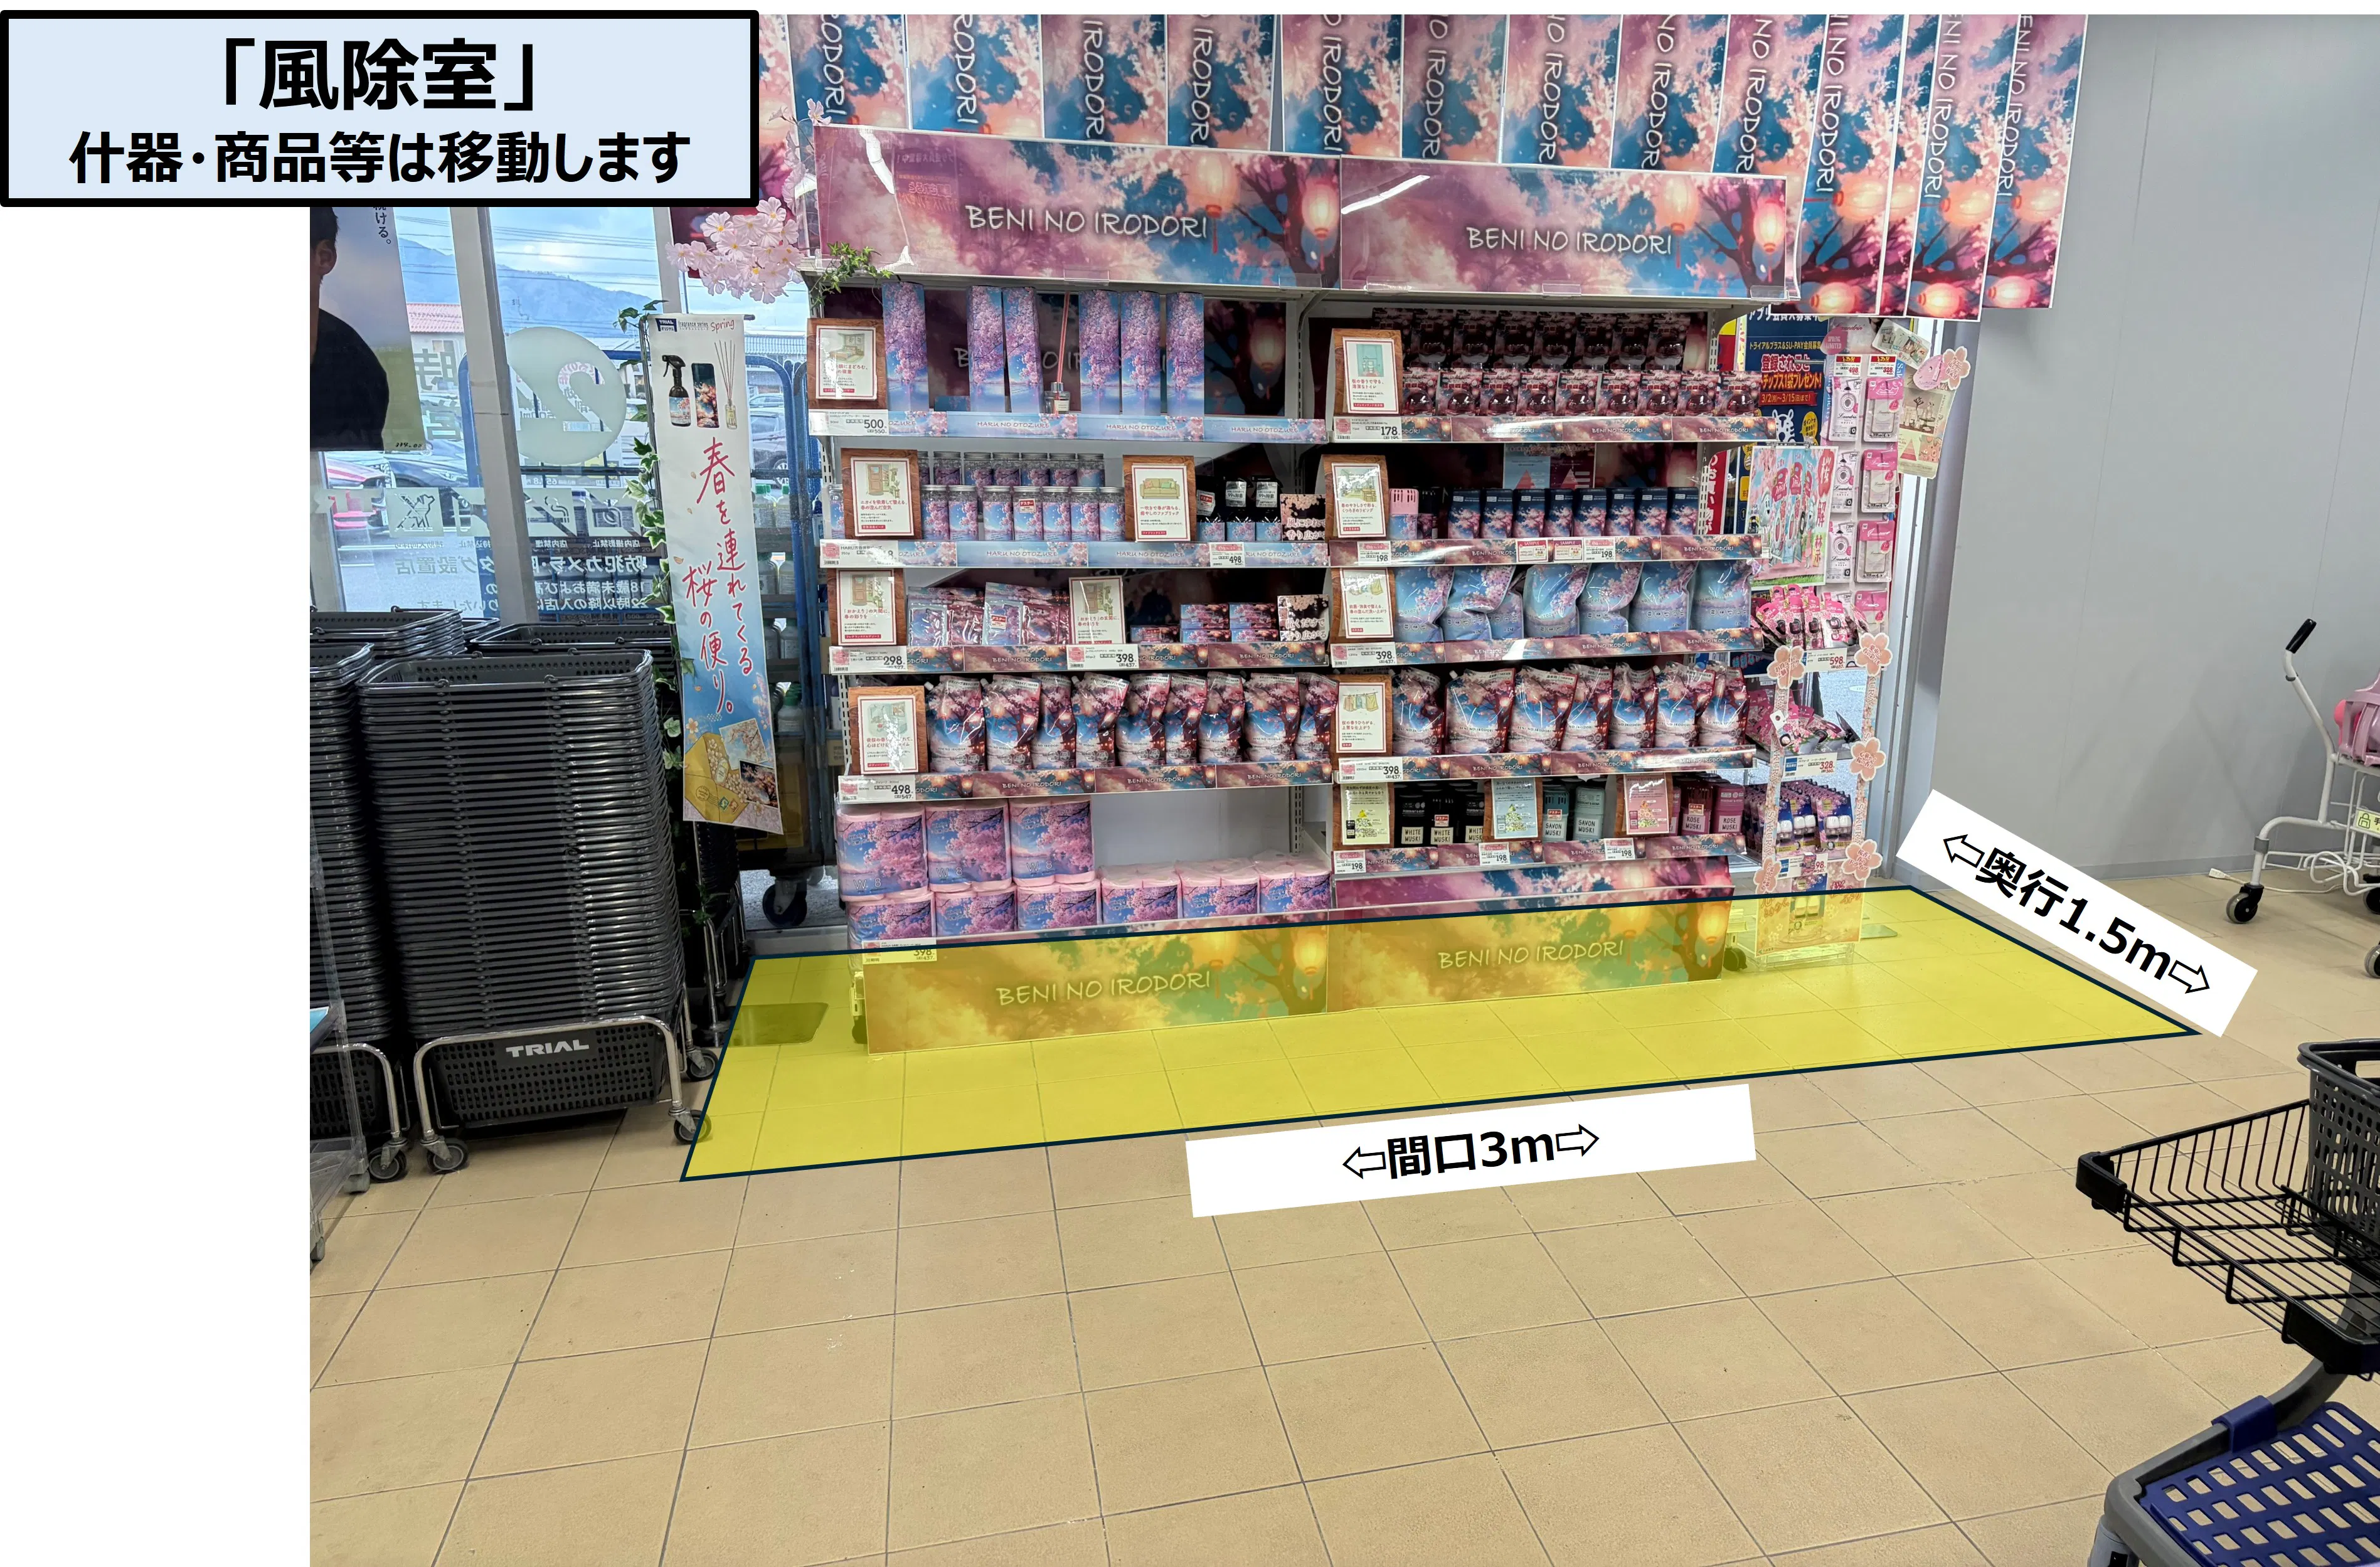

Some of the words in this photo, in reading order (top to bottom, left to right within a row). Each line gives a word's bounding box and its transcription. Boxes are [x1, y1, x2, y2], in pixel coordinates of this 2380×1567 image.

[1751, 18, 1773, 59] NO
[1827, 36, 1846, 76] NO
[1939, 56, 1958, 90] NO
[1323, 37, 1343, 151] IRODORI
[1816, 85, 1843, 192] IRODORI
[1925, 99, 1952, 198] IRODORI
[373, 207, 391, 244] ける。
[965, 205, 1034, 231] BENI
[1044, 210, 1085, 233] NO
[1095, 212, 1207, 238] IRODORI
[1466, 226, 1524, 250] BENI
[1534, 230, 1568, 251] NO
[1576, 231, 1671, 254] IRODORI
[711, 319, 735, 334] Spring
[864, 419, 884, 428] 500
[1381, 427, 1398, 435] 178
[696, 436, 753, 676] 春を連れてくる
[682, 560, 733, 714] 桜の便り。
[883, 656, 903, 666] 298
[1116, 654, 1134, 662] 398
[1376, 651, 1392, 659] 398
[1830, 656, 1844, 664] 598
[1383, 766, 1399, 775] 398
[1820, 761, 1834, 770] 328
[891, 785, 911, 794] 498
[1578, 819, 1595, 827] SAVON
[955, 867, 963, 876] 8
[1046, 860, 1053, 869] 8
[874, 877, 881, 887] 8
[1438, 949, 1489, 970] BENI
[1497, 947, 1529, 965] NO
[1536, 940, 1623, 962] IRODORI
[996, 984, 1056, 1006] BENI
[1067, 980, 1103, 1001] NO
[1111, 971, 1210, 995] IRODORI
[506, 1039, 589, 1058] TRIAL
